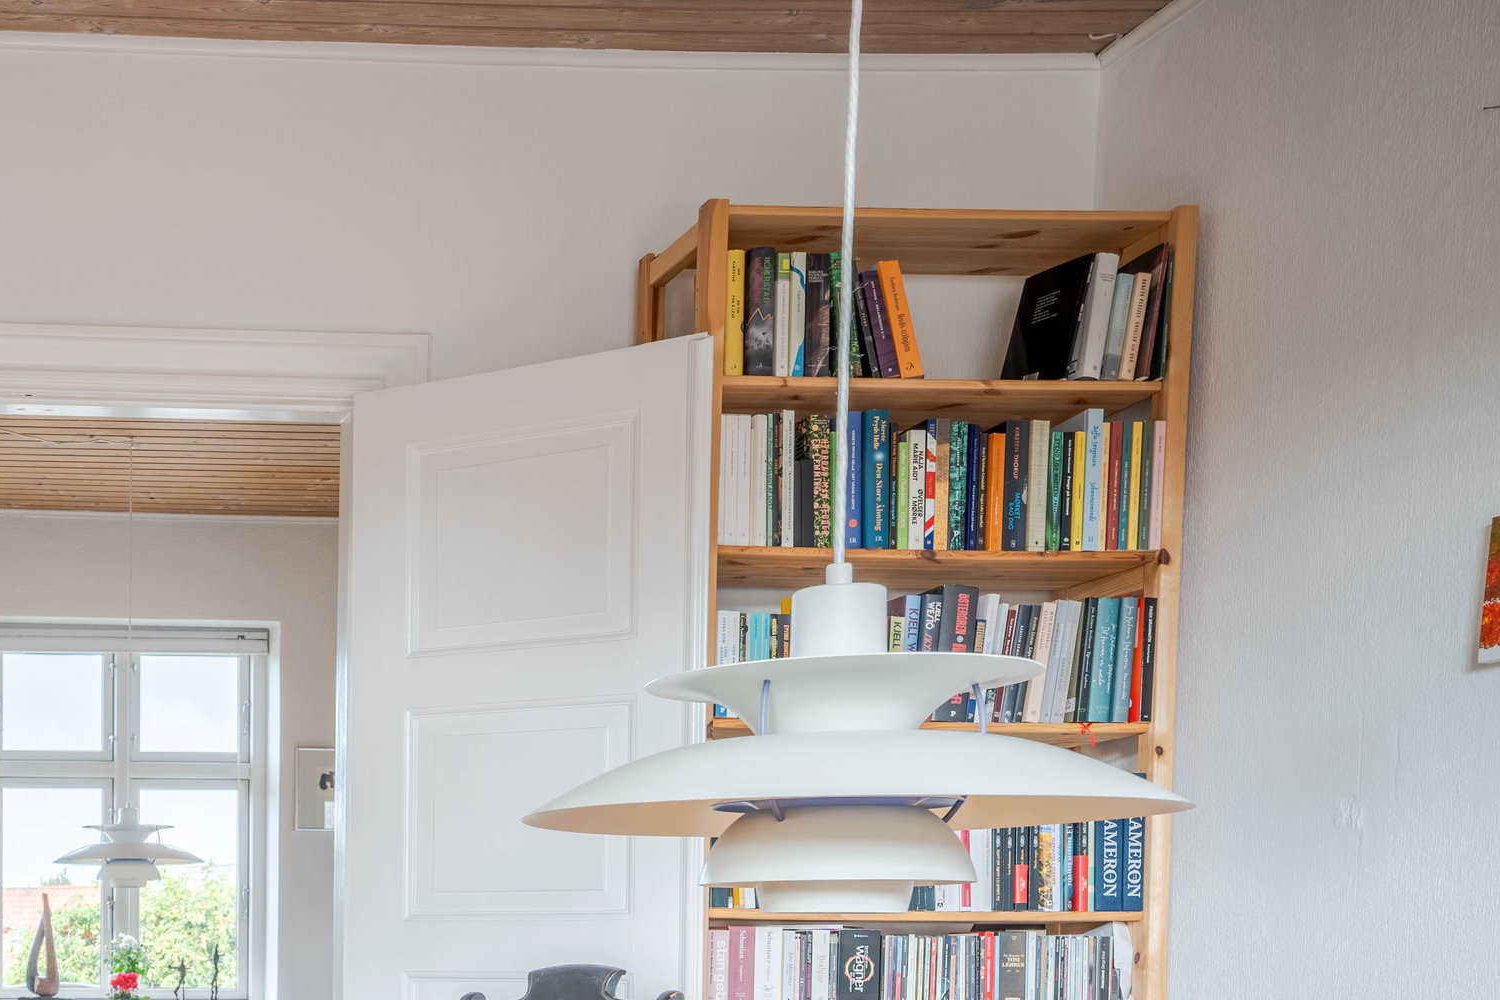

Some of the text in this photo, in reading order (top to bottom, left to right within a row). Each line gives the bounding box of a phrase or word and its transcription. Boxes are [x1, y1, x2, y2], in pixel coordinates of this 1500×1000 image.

[1089, 426, 1100, 522] Sofie Jørgensen Johannesminde
[874, 503, 884, 531] Åbning
[908, 608, 919, 638] KJELL
[955, 593, 969, 635] ÖSTERGREN
[893, 622, 902, 648] KJELL
[715, 940, 727, 970] stan
[818, 955, 826, 983] Brahms
[853, 946, 867, 992] wagner
